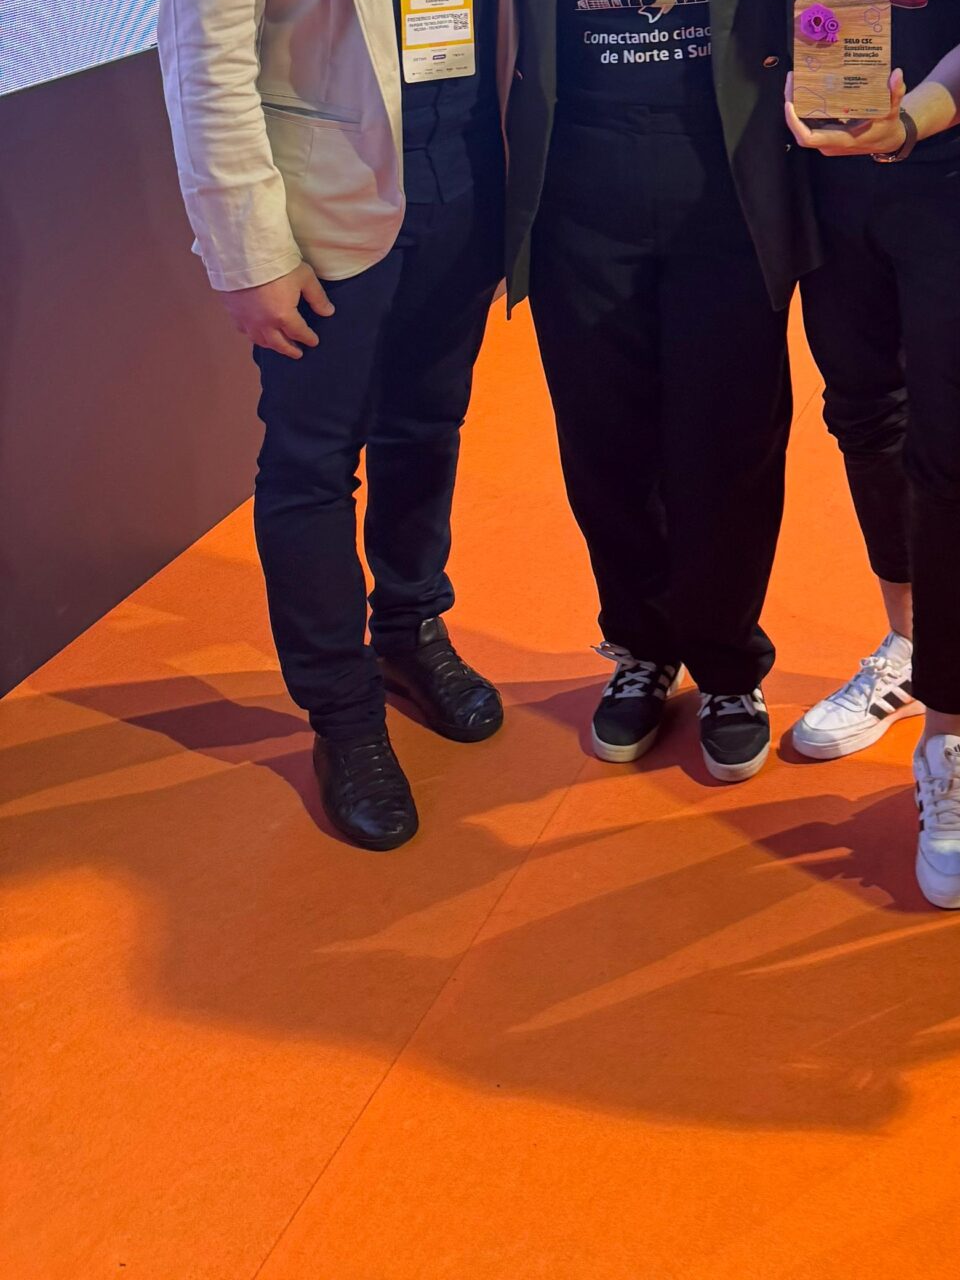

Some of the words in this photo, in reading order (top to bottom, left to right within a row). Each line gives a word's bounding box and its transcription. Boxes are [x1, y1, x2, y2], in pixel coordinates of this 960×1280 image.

[584, 29, 669, 44] Conectando
[600, 50, 619, 63] de
[623, 49, 669, 63] Norte
[674, 48, 683, 59] a
[687, 42, 711, 58] Sul
